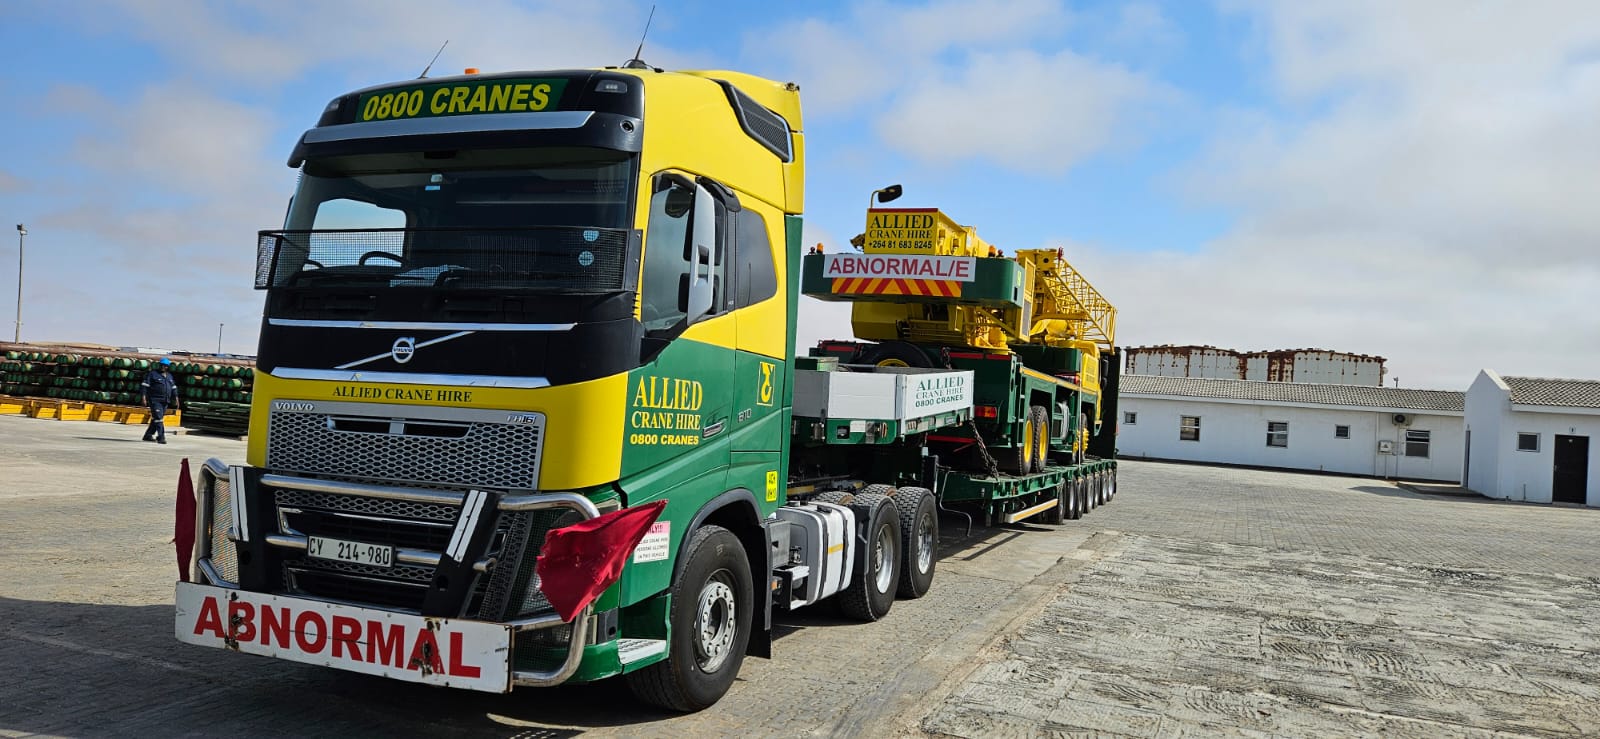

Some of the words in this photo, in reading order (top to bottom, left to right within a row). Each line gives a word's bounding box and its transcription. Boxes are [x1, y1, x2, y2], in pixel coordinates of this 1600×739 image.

[363, 90, 424, 121] 0800
[430, 84, 551, 115] CRANES
[870, 214, 934, 229] ALLIED
[869, 229, 904, 239] CRANE
[907, 230, 933, 239] HIRE
[868, 240, 886, 249] +264
[887, 240, 896, 249] 81
[899, 241, 912, 249] 683
[914, 241, 933, 249] 8245
[828, 257, 970, 278] ABNORMAL/E
[916, 376, 964, 391] ALLIED
[332, 386, 382, 399] ALLIED
[385, 388, 433, 401] CRANE
[437, 390, 472, 403] HIRE
[632, 375, 703, 411] ALLIED
[916, 390, 944, 400] CRANE
[946, 387, 964, 395] HIRE
[275, 401, 315, 411] VOLVO
[915, 398, 935, 408] 0800
[936, 394, 964, 404] CRANES
[631, 410, 674, 429] CRANE
[676, 414, 701, 430] HIRE
[630, 433, 658, 445] 0800
[660, 434, 699, 445] CRANES
[309, 537, 324, 556] CY
[338, 541, 390, 565] 214-980
[193, 595, 482, 679] ABNORMAL
